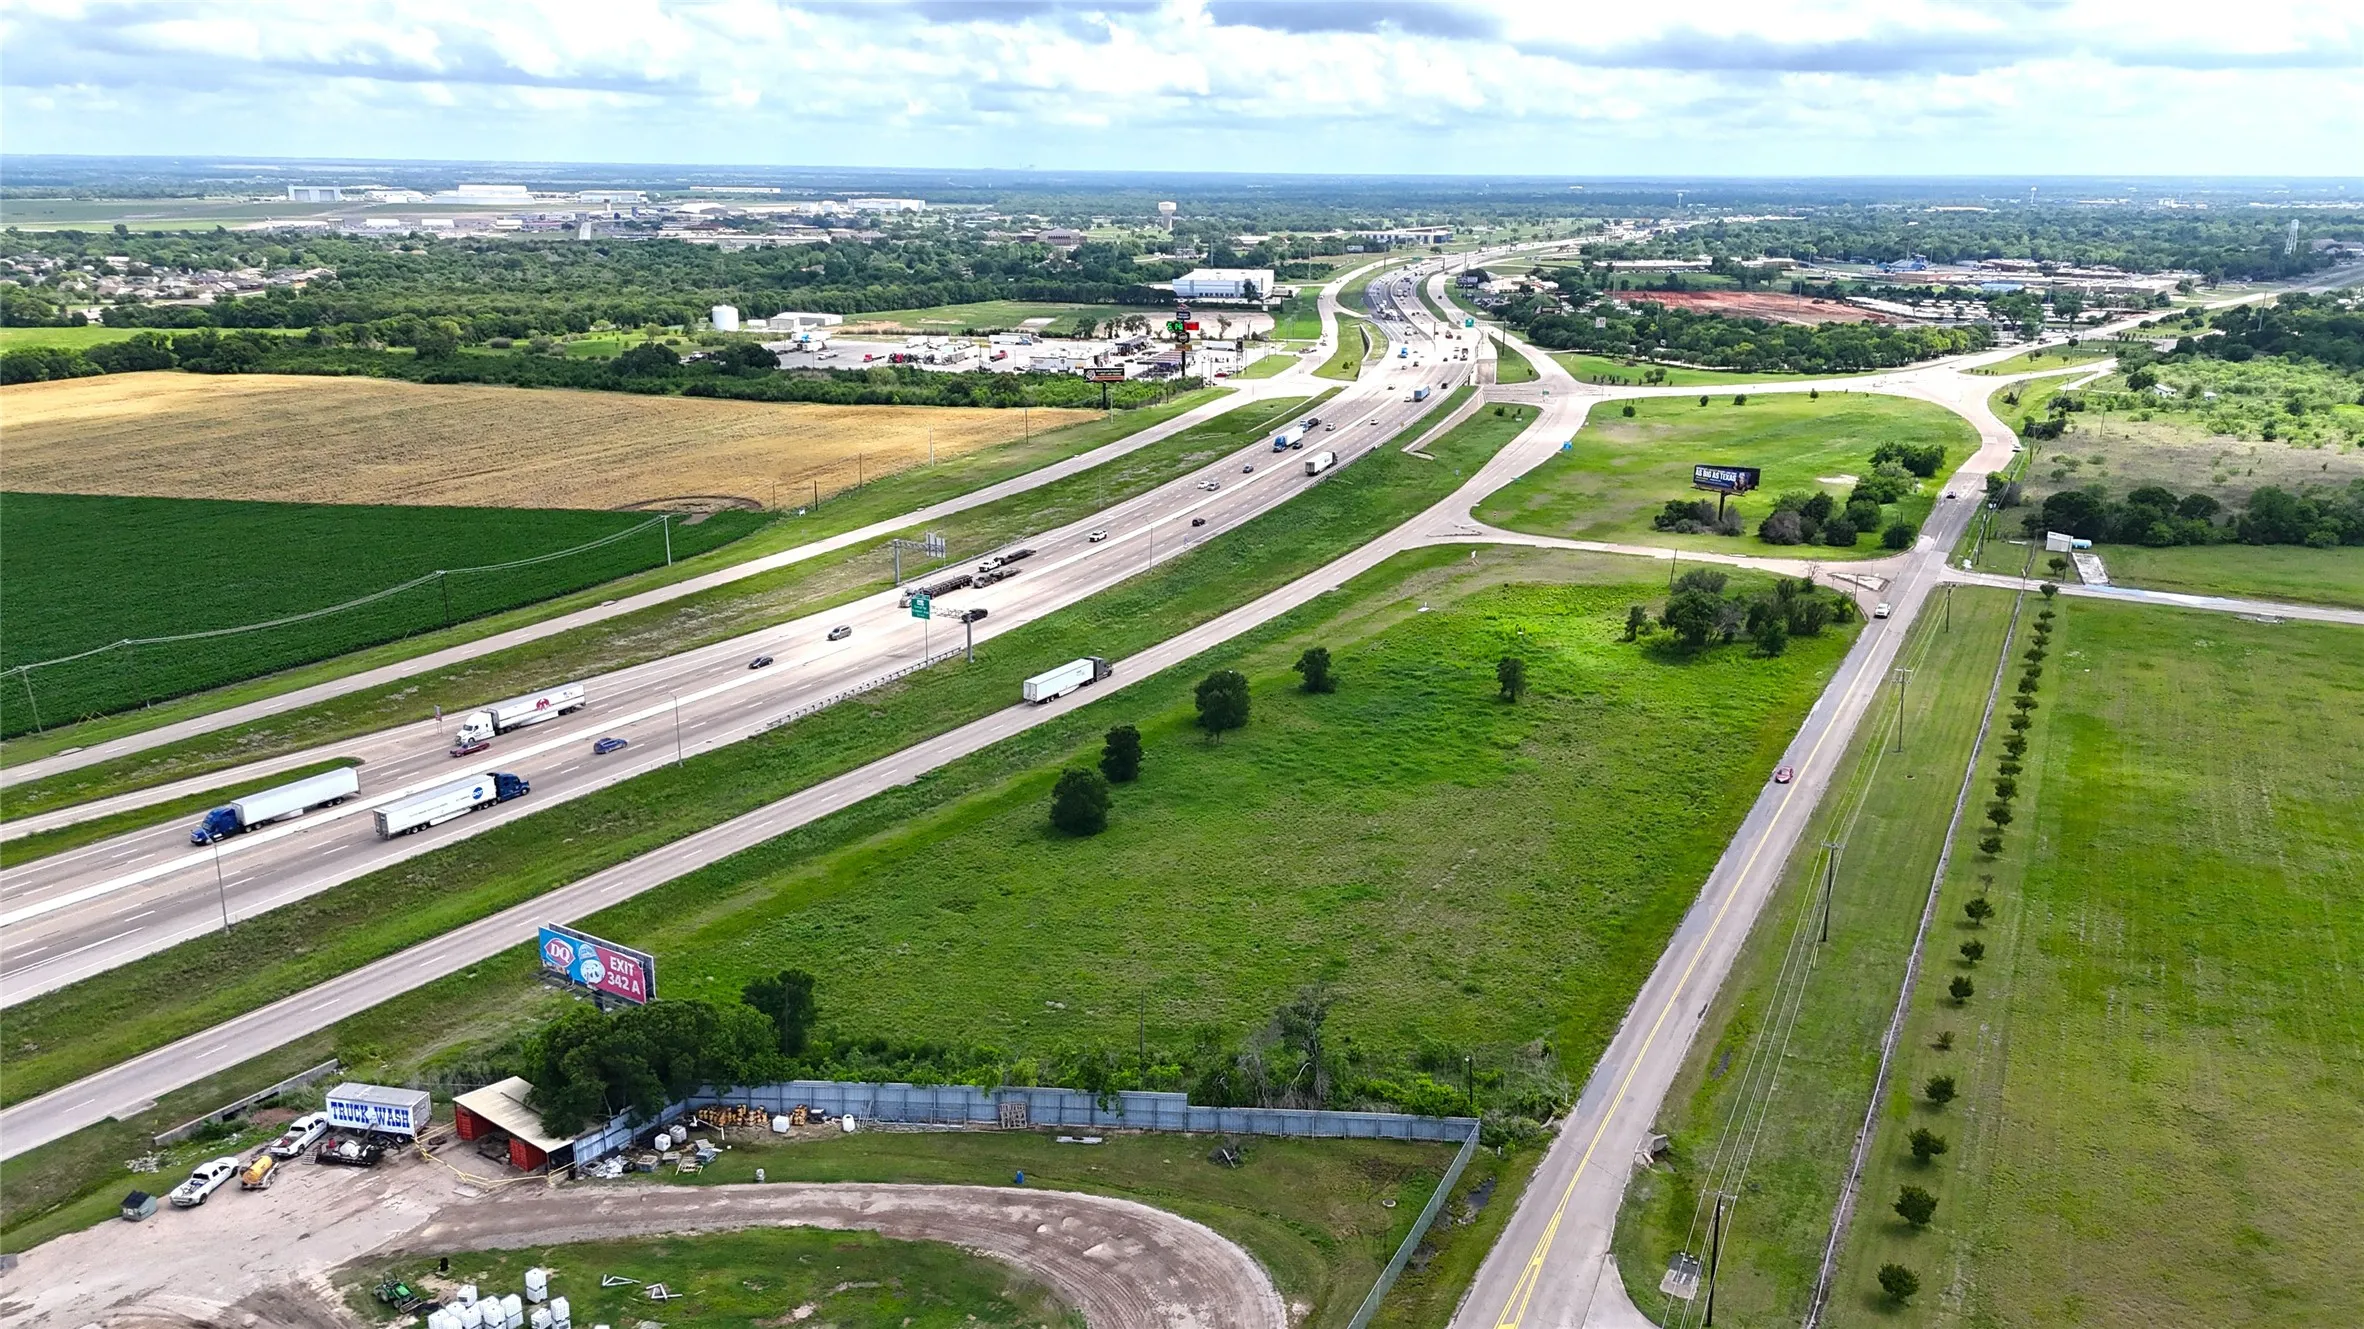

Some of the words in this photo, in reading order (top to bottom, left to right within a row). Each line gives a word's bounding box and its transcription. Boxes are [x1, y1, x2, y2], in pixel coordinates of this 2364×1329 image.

[1702, 469, 1711, 478] BIG
[1720, 472, 1736, 482] TEXAS
[550, 943, 570, 963] DQ
[609, 956, 635, 976] EXIT
[607, 971, 630, 991] 342
[631, 982, 641, 995] A
[330, 1101, 370, 1124] TRUCK
[373, 1106, 410, 1129] WASH
